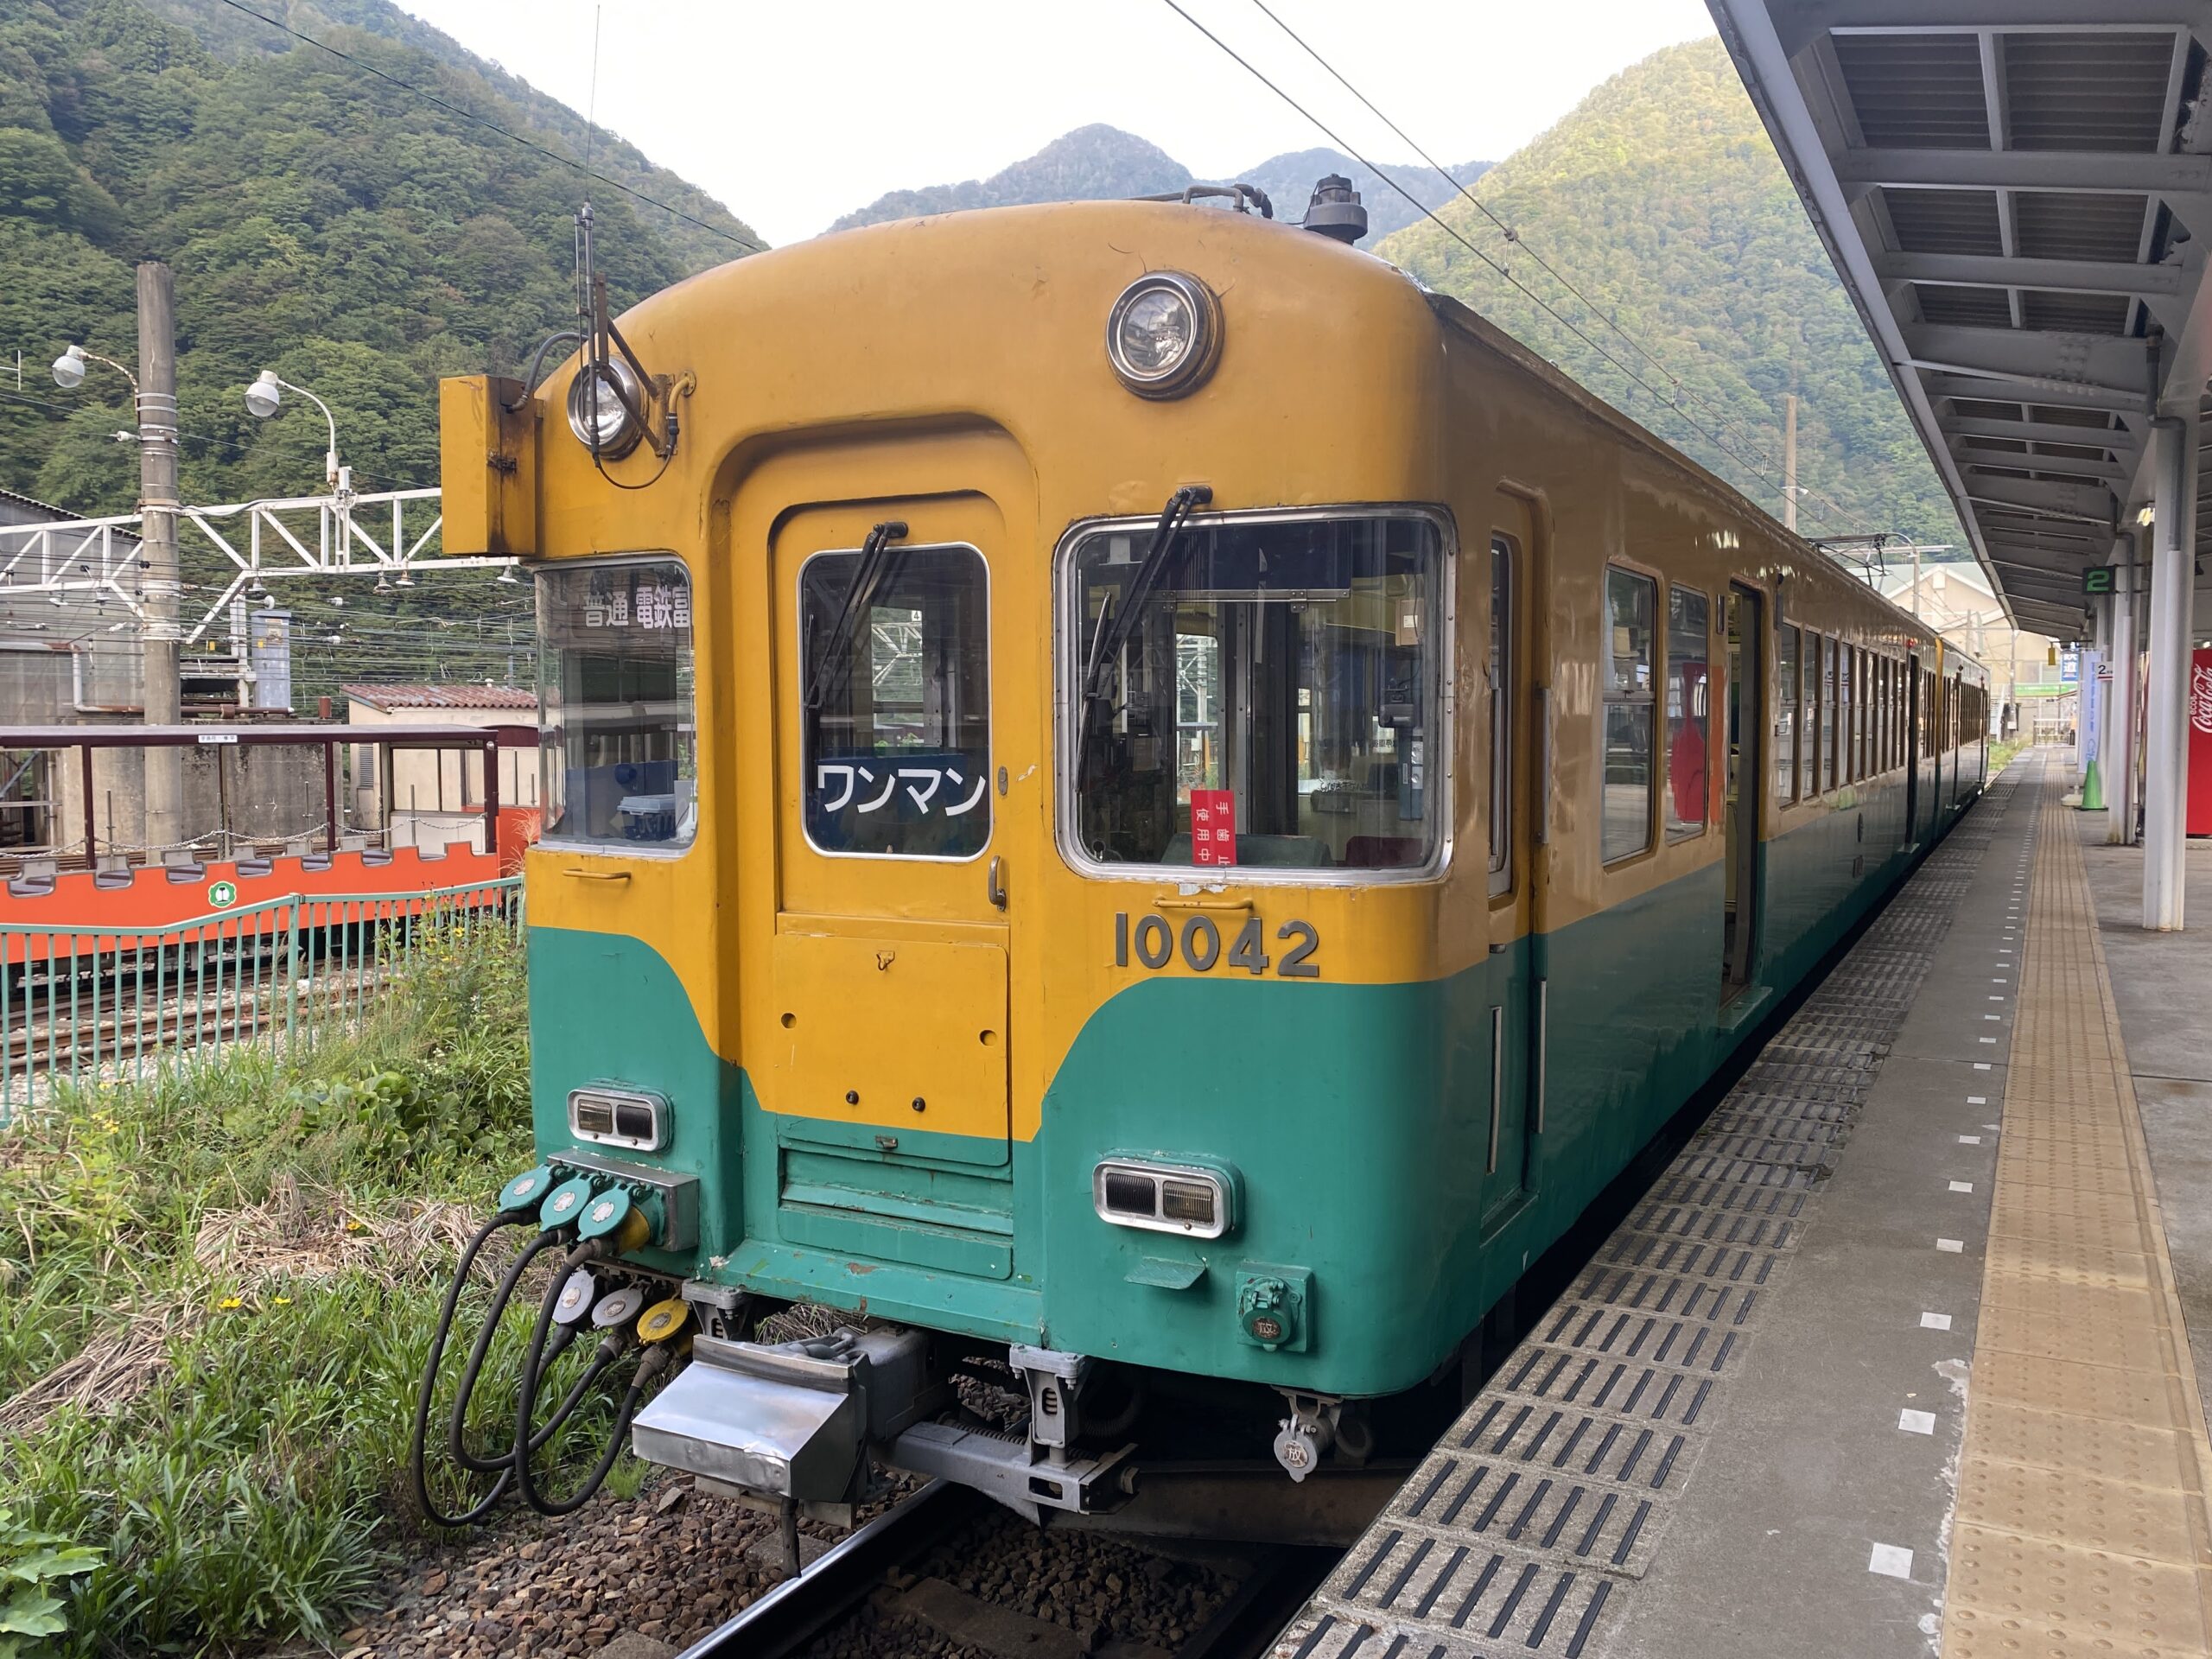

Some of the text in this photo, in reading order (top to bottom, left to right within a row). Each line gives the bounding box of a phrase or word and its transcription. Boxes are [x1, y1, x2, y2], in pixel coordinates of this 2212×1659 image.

[2087, 570, 2109, 591] 2
[582, 591, 629, 626] 普通
[913, 610, 920, 620] 4
[2098, 664, 2107, 675] 2
[817, 765, 986, 817] ワンマン
[1196, 808, 1211, 861] 使用中
[1115, 912, 1319, 976] 10042
